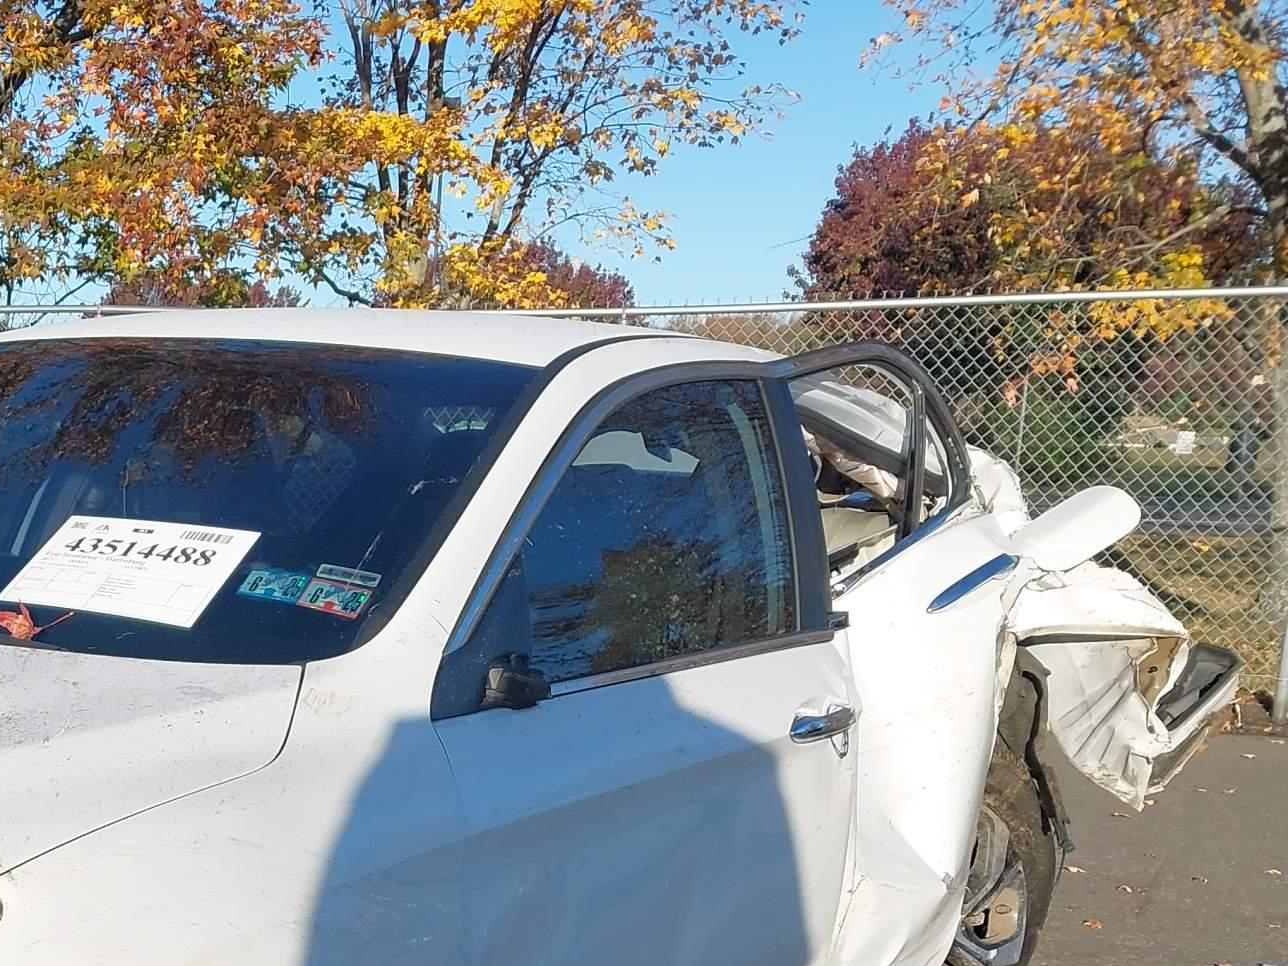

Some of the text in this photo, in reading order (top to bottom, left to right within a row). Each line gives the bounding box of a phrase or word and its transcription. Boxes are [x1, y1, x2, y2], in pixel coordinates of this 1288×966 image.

[64, 536, 217, 567] 43514488
[248, 576, 264, 592] 6
[309, 587, 324, 604] 6
